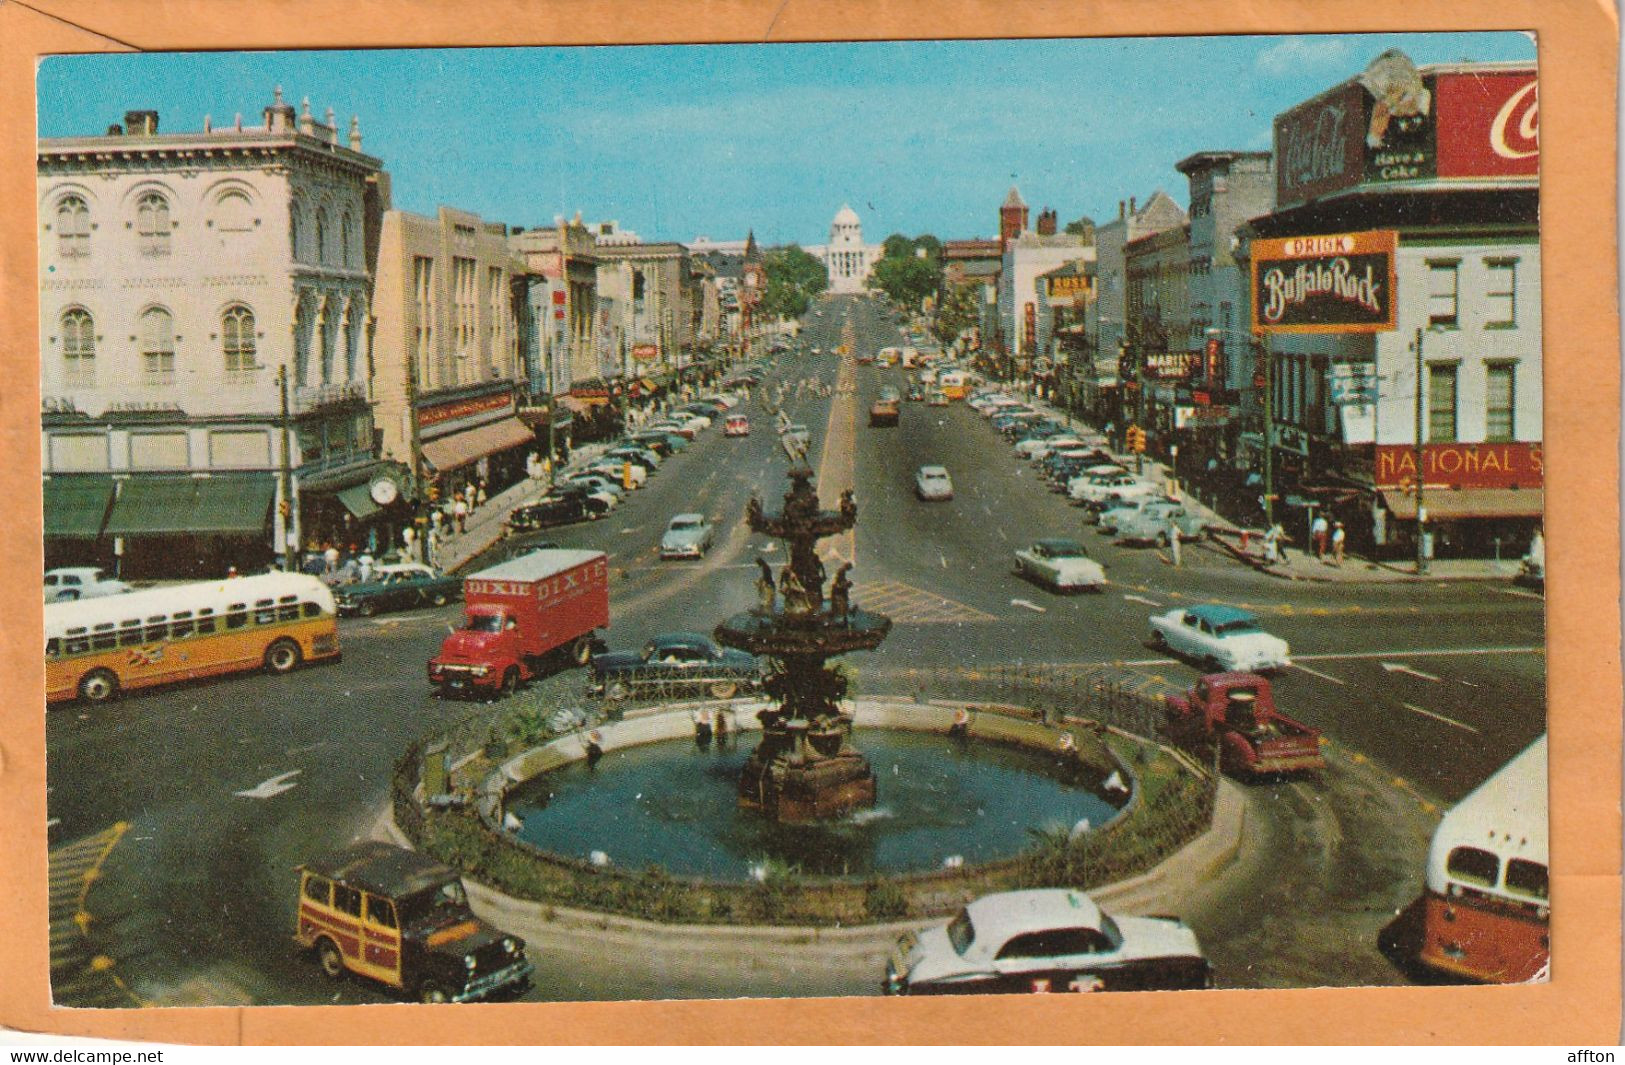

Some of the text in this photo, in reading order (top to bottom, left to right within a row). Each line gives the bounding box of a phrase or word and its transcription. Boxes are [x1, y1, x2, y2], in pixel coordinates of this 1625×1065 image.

[1375, 153, 1411, 166] Have
[1381, 166, 1418, 180] Coke
[1294, 238, 1346, 254] DRINK
[1264, 256, 1381, 322] Buffalo Rock
[1380, 450, 1513, 479] NAIONAL
[537, 560, 606, 600] DIXIE
[468, 581, 531, 596] DIXIE
